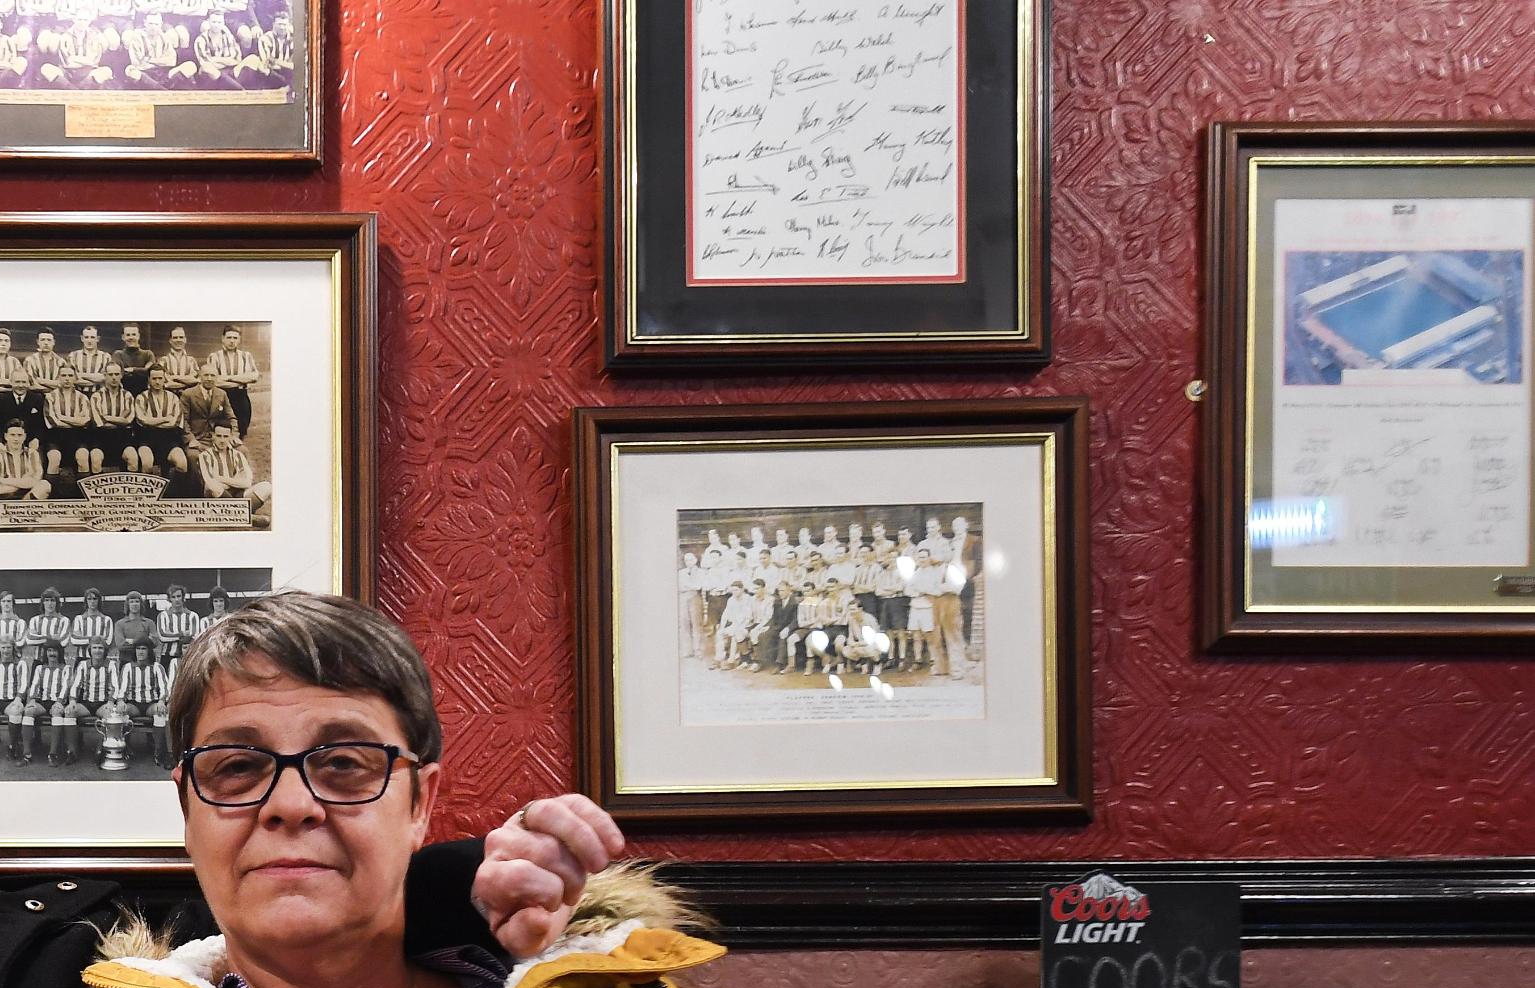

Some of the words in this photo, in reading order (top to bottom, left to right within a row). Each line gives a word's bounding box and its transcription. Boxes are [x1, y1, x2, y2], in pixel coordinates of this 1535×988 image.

[84, 475, 164, 490] SUNDERLAND
[94, 486, 120, 495] CUP
[120, 485, 154, 495] TEAM
[1049, 884, 1152, 922] Coors
[1054, 922, 1146, 944] LIGHT
